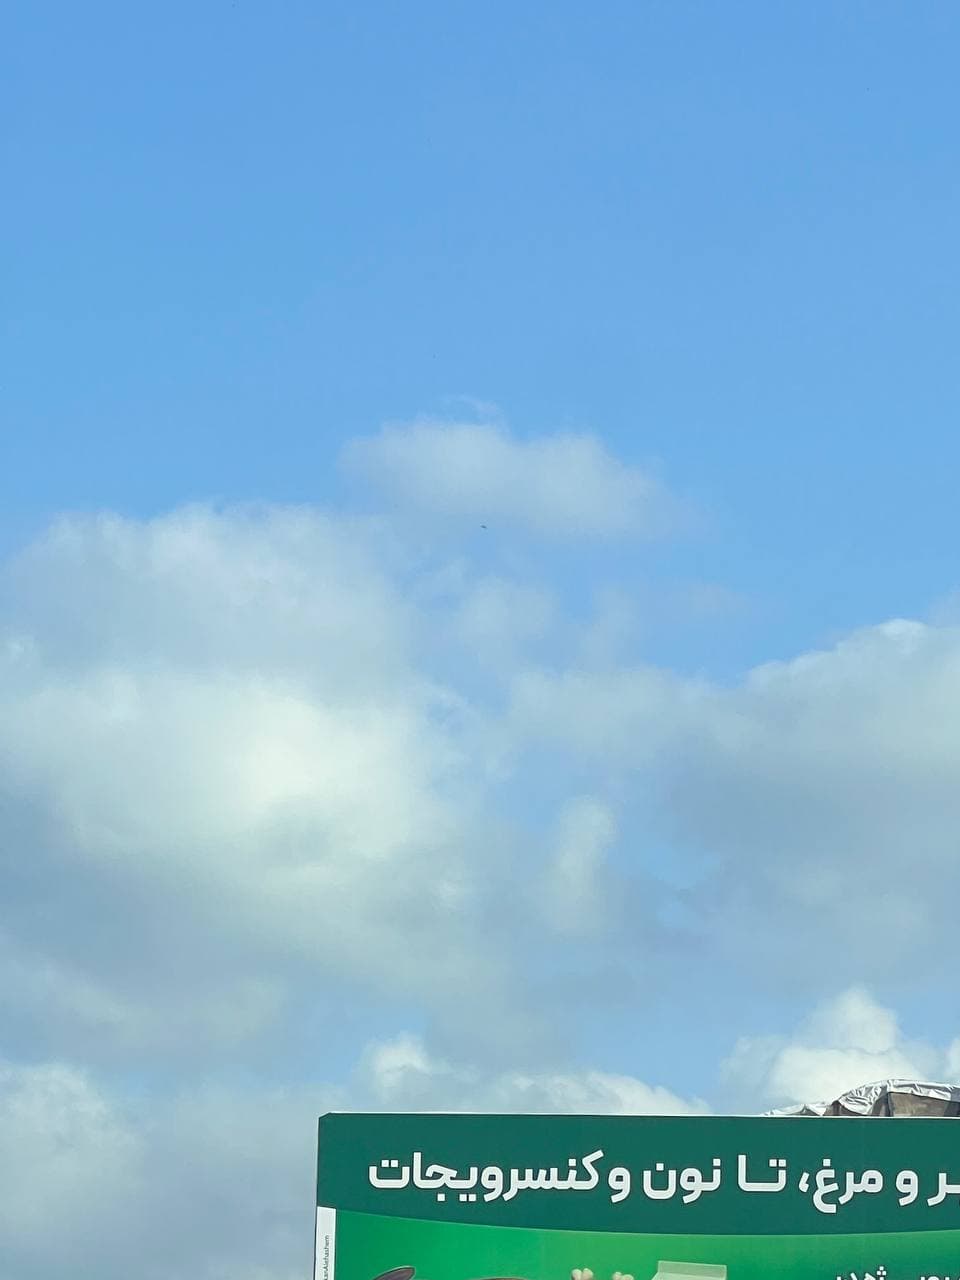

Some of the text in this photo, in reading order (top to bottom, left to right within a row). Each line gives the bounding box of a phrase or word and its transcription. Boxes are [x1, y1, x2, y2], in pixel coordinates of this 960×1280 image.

[368, 1149, 604, 1202] کنسرویجات
[607, 1166, 631, 1203] و
[643, 1158, 722, 1204] نون
[738, 1154, 787, 1192] تا
[799, 1158, 884, 1214] مرغ،
[895, 1169, 919, 1206] و
